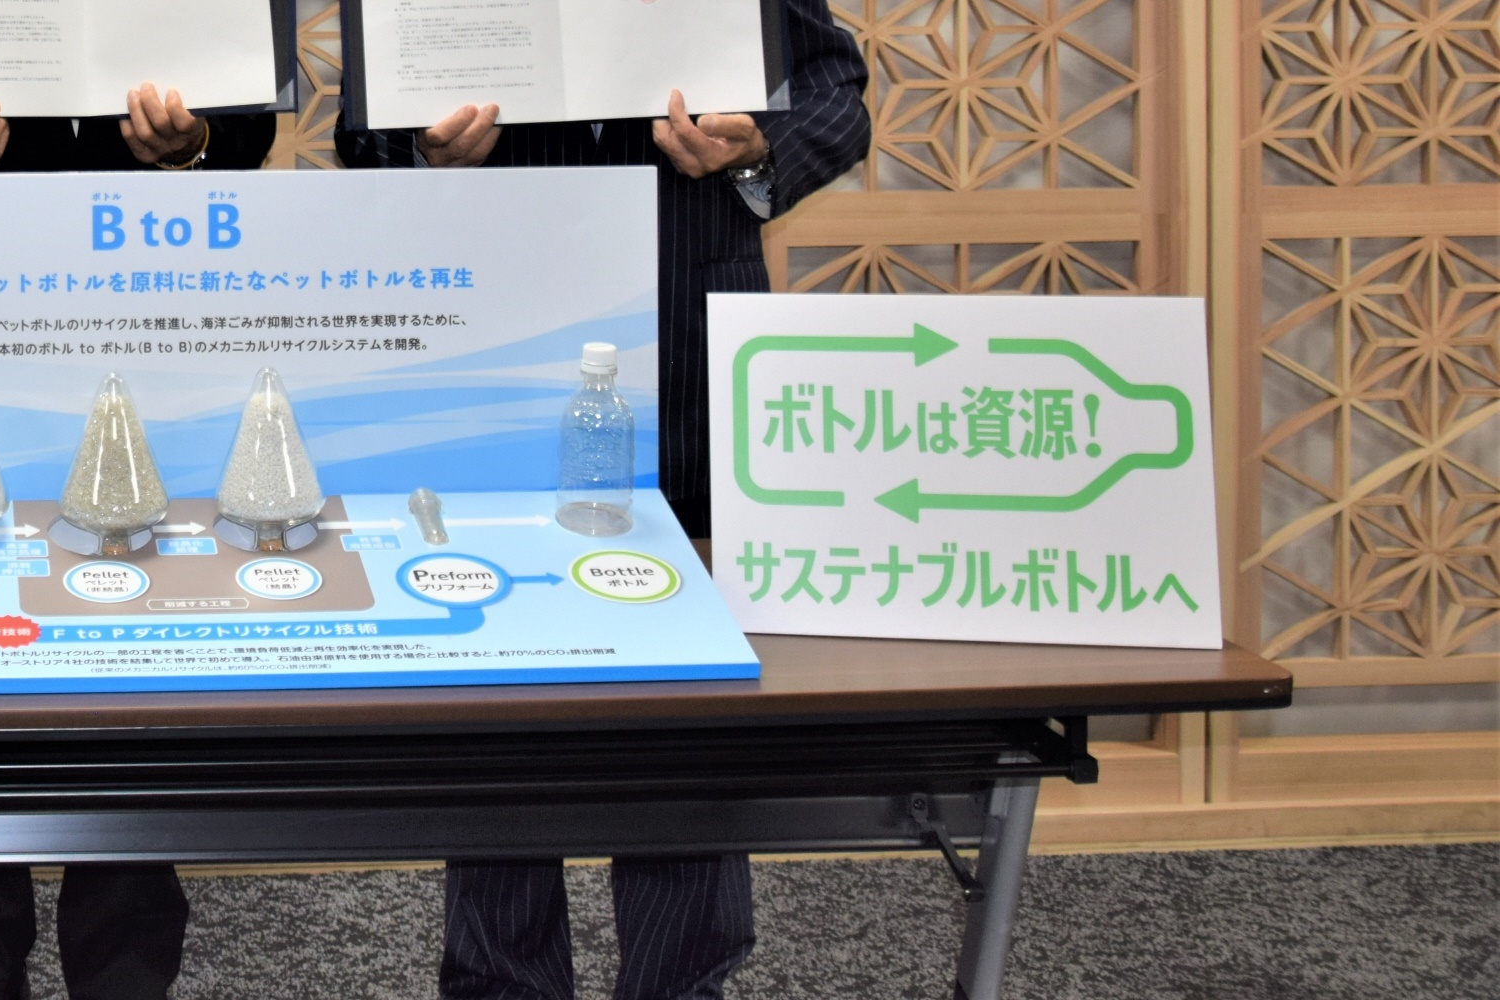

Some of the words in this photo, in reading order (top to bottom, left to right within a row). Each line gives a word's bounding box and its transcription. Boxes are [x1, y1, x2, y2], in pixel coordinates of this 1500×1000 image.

[92, 192, 121, 201] ボトル
[207, 191, 237, 200] ボトル
[92, 205, 126, 251] B
[140, 210, 192, 247] to
[208, 203, 242, 249] B
[79, 344, 95, 355] to
[158, 342, 173, 353] to
[762, 383, 1102, 461] ボトルは資源!
[82, 571, 129, 579] Pellet
[254, 568, 301, 576] Pellet
[413, 570, 493, 582] Preform
[590, 567, 655, 577] Bottle
[608, 579, 649, 588] ボトル
[736, 542, 1200, 614] サステナブルボトルへ
[417, 582, 495, 592] プリフォーム
[53, 628, 65, 640] F
[77, 628, 102, 639] to
[112, 627, 125, 639] P
[133, 623, 378, 639] ダイレクトリサイクル技術
